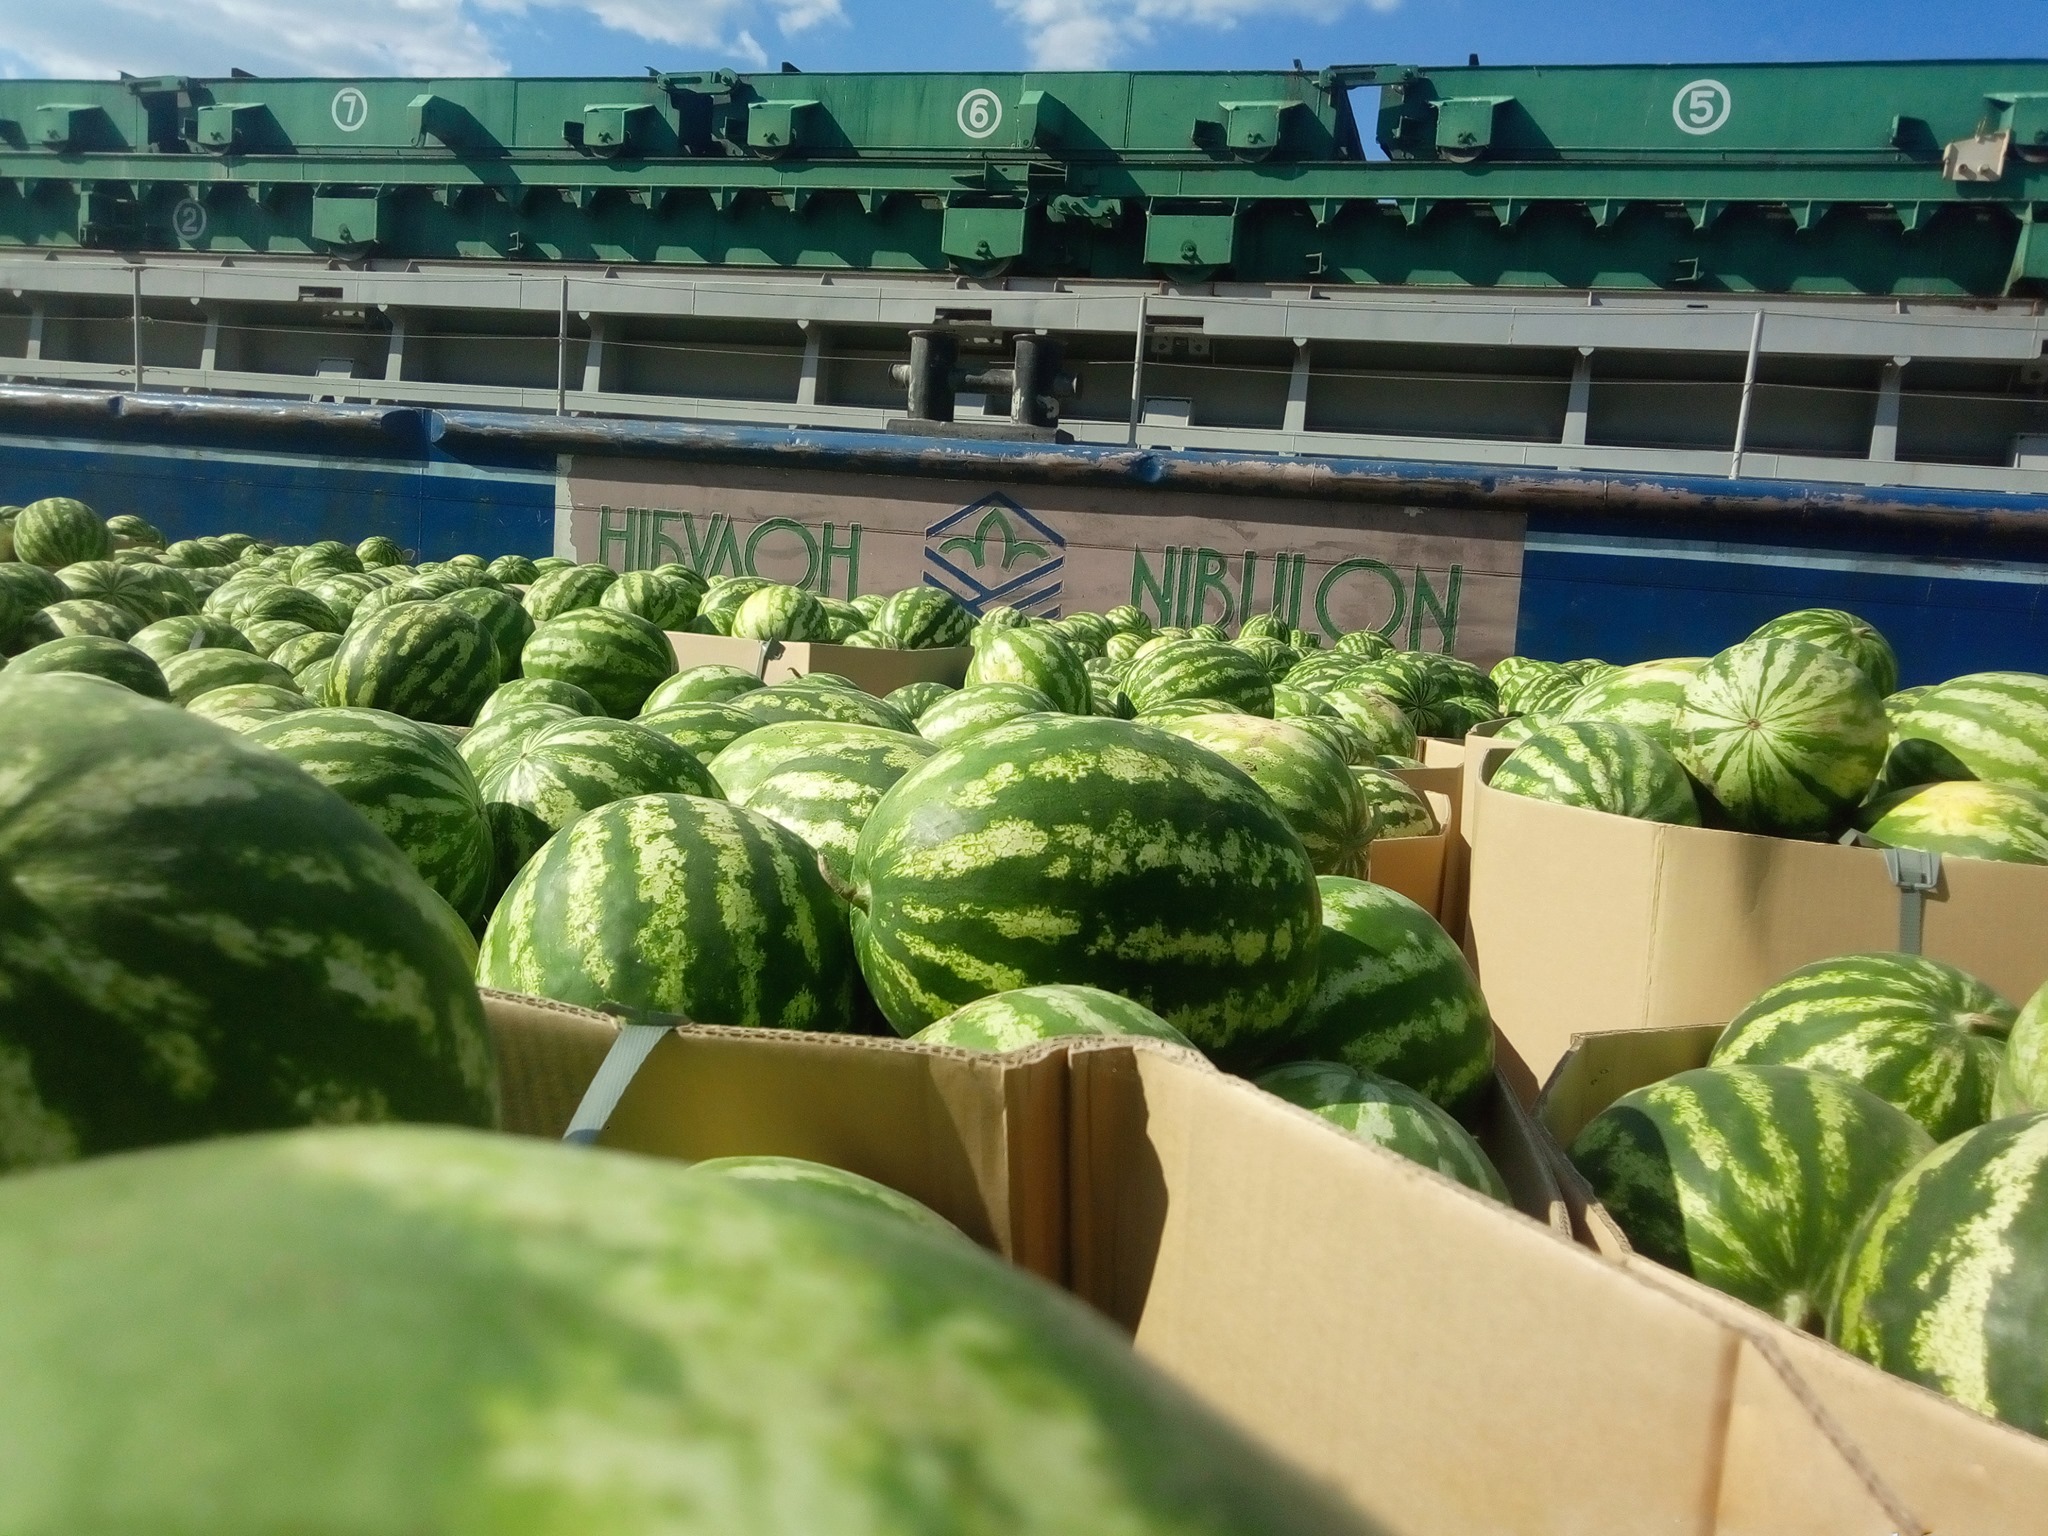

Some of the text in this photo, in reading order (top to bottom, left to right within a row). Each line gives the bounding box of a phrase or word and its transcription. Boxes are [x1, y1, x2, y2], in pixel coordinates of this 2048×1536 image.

[342, 97, 358, 123] 7
[969, 98, 990, 129] 6
[1689, 90, 1714, 124] 5
[181, 206, 198, 232] 2
[1130, 543, 1463, 655] NIBULON
